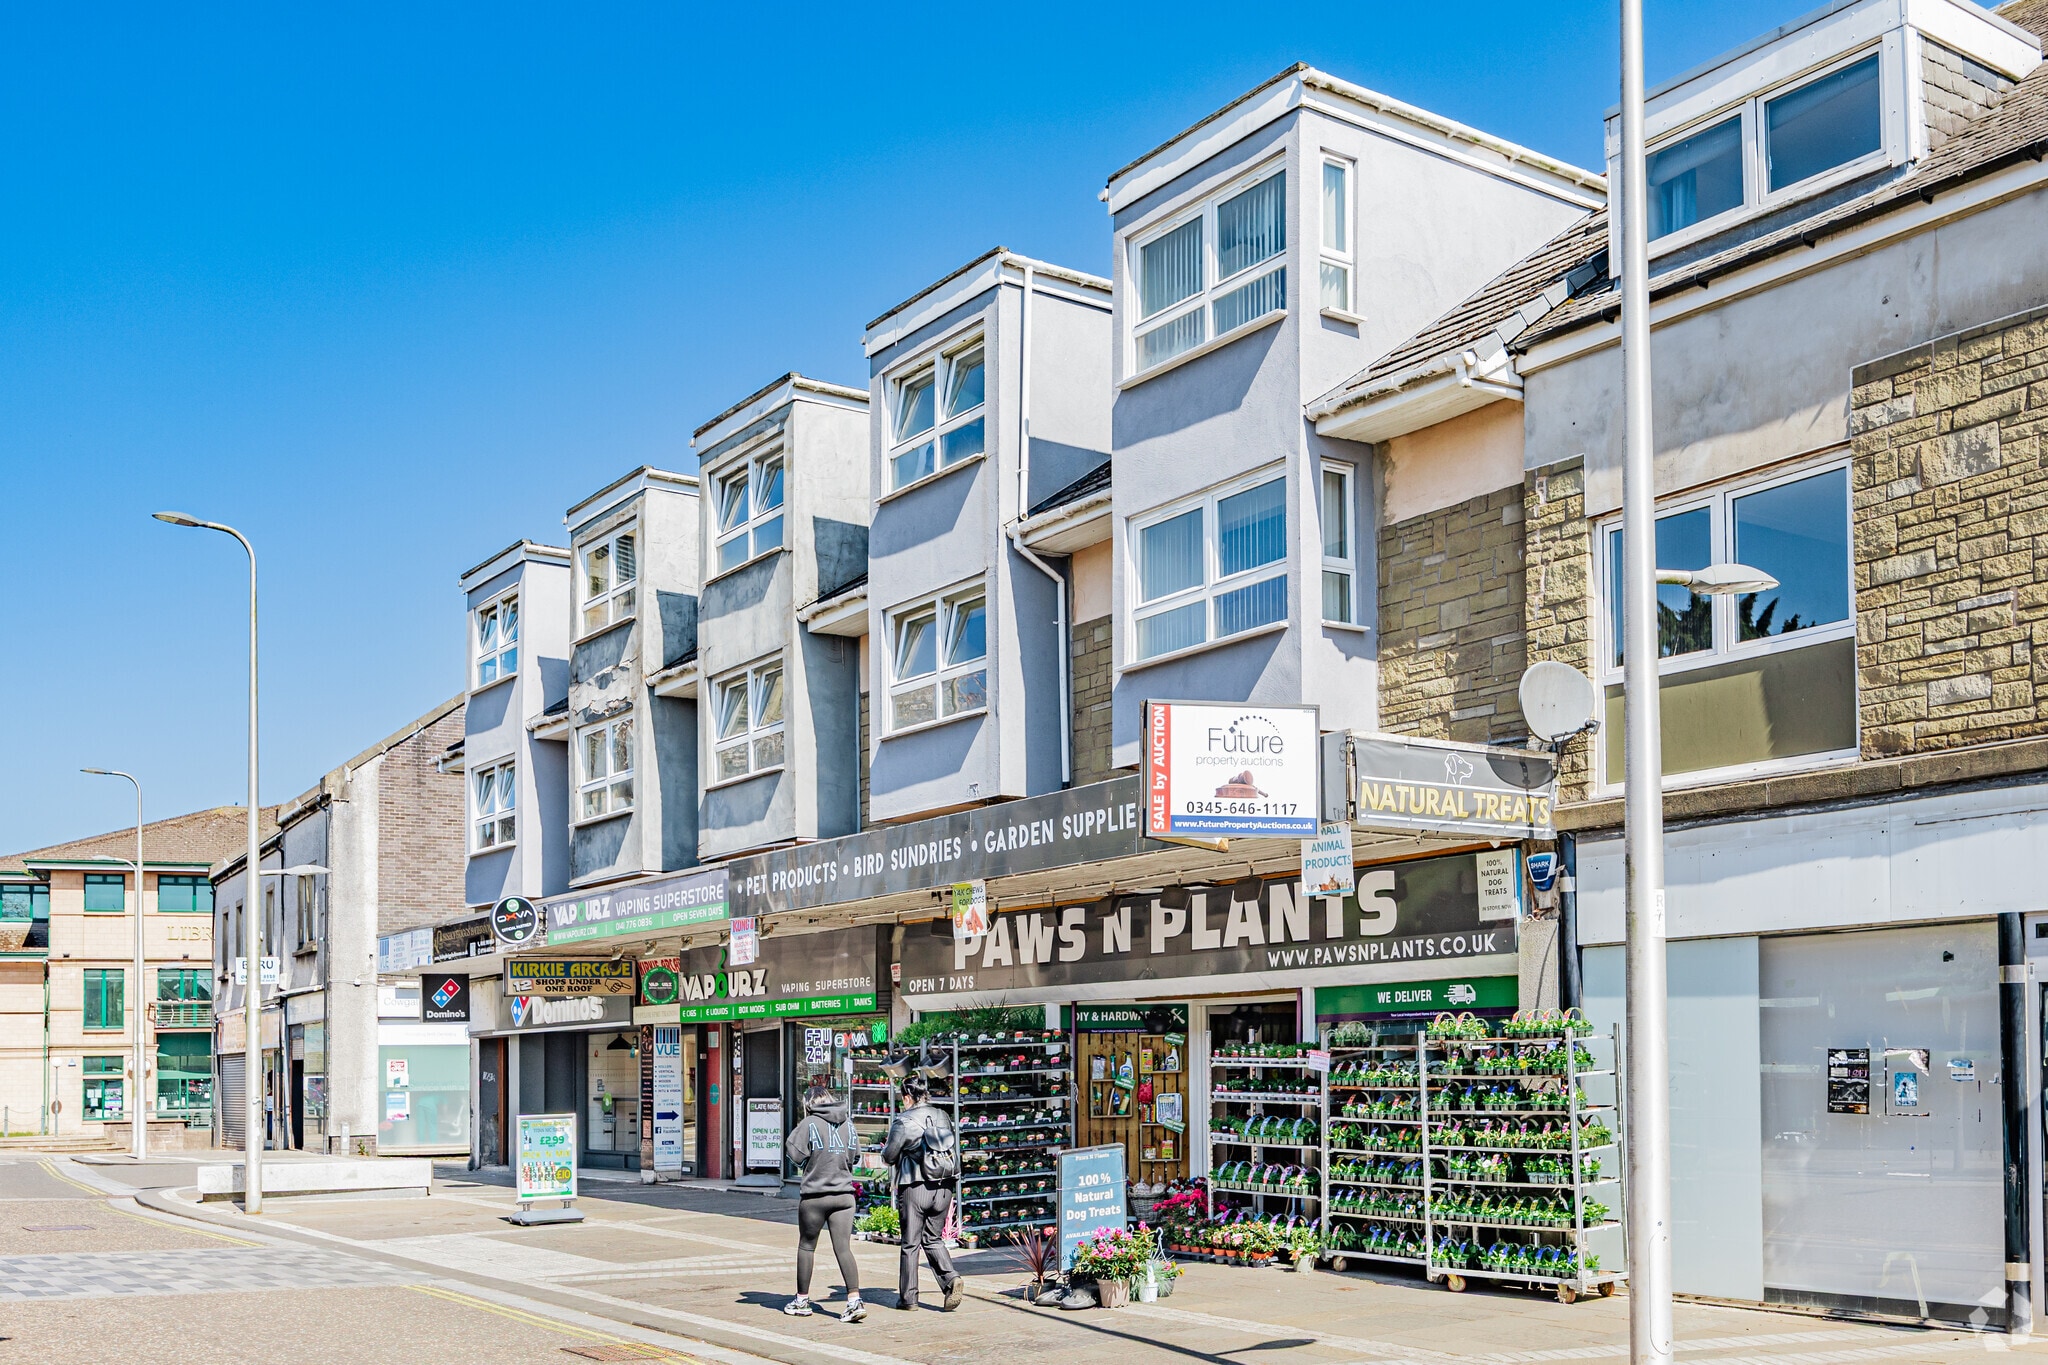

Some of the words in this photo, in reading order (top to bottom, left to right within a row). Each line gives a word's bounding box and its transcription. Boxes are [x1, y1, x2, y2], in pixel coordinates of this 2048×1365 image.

[1154, 706, 1165, 767] AUCTION
[1208, 728, 1284, 754] Future
[1196, 756, 1240, 767] property
[1240, 756, 1284, 766] auctions
[1153, 773, 1167, 790] by
[1186, 801, 1297, 816] 0345-646-1117
[1360, 782, 1469, 818] NATURAL
[1473, 792, 1550, 825] TREATS
[1154, 795, 1165, 830] SALE
[1174, 820, 1313, 830] www.FuturePropertyAuctions.co.uk
[1321, 825, 1341, 836] MALL
[746, 874, 768, 896] PET
[772, 861, 837, 892] PRODUCTS
[853, 854, 884, 878] BIRD
[890, 837, 962, 869] SUNDRIES
[984, 818, 1054, 854] GARDEN
[1062, 802, 1138, 840] SUPPLIE
[1312, 840, 1345, 853] ANIMAL
[1305, 855, 1352, 870] PRODUCTS
[1530, 860, 1550, 868] SHARK
[1481, 868, 1508, 877] NATURAL
[966, 886, 983, 895] CHEWS
[1484, 888, 1508, 896] TREATS
[553, 897, 610, 927] VAPOURZ
[616, 897, 650, 916] VAPING
[654, 884, 724, 910] SUPERSTORE
[970, 896, 984, 905] DOGS
[672, 912, 688, 922] OPEN
[689, 909, 707, 920] SEVEN
[708, 906, 722, 916] DAYS
[954, 908, 1086, 970] PAWS
[1103, 906, 1132, 954] N
[1150, 870, 1398, 954] PLANTS
[625, 919, 636, 930] 776
[168, 926, 212, 940] LIBR
[1268, 933, 1496, 968] WWW.PAWSNPLANTS.CO.UK
[512, 962, 564, 977] KIRKIE
[512, 980, 533, 992] 12
[682, 969, 766, 1002] VAPOURZ
[782, 982, 810, 994] VAPING
[816, 976, 870, 990] SUPERSTORE
[909, 977, 934, 992] OPEN
[940, 978, 944, 990] 7
[950, 976, 974, 990] DAYS
[854, 998, 872, 1006] TANKS
[1378, 992, 1392, 1004] WE
[1394, 990, 1432, 1002] DELIVER
[788, 1002, 800, 1010] OHM
[812, 1000, 841, 1009] BATTERIES
[426, 1010, 466, 1018] Domino's
[1092, 1012, 1099, 1022] &
[656, 1044, 680, 1056] VUE
[540, 1136, 564, 1145] £2.99
[556, 1170, 570, 1178] £10
[1074, 1188, 1114, 1202] Natural
[1066, 1209, 1086, 1221] Dog
[1088, 1205, 1121, 1217] Treats
